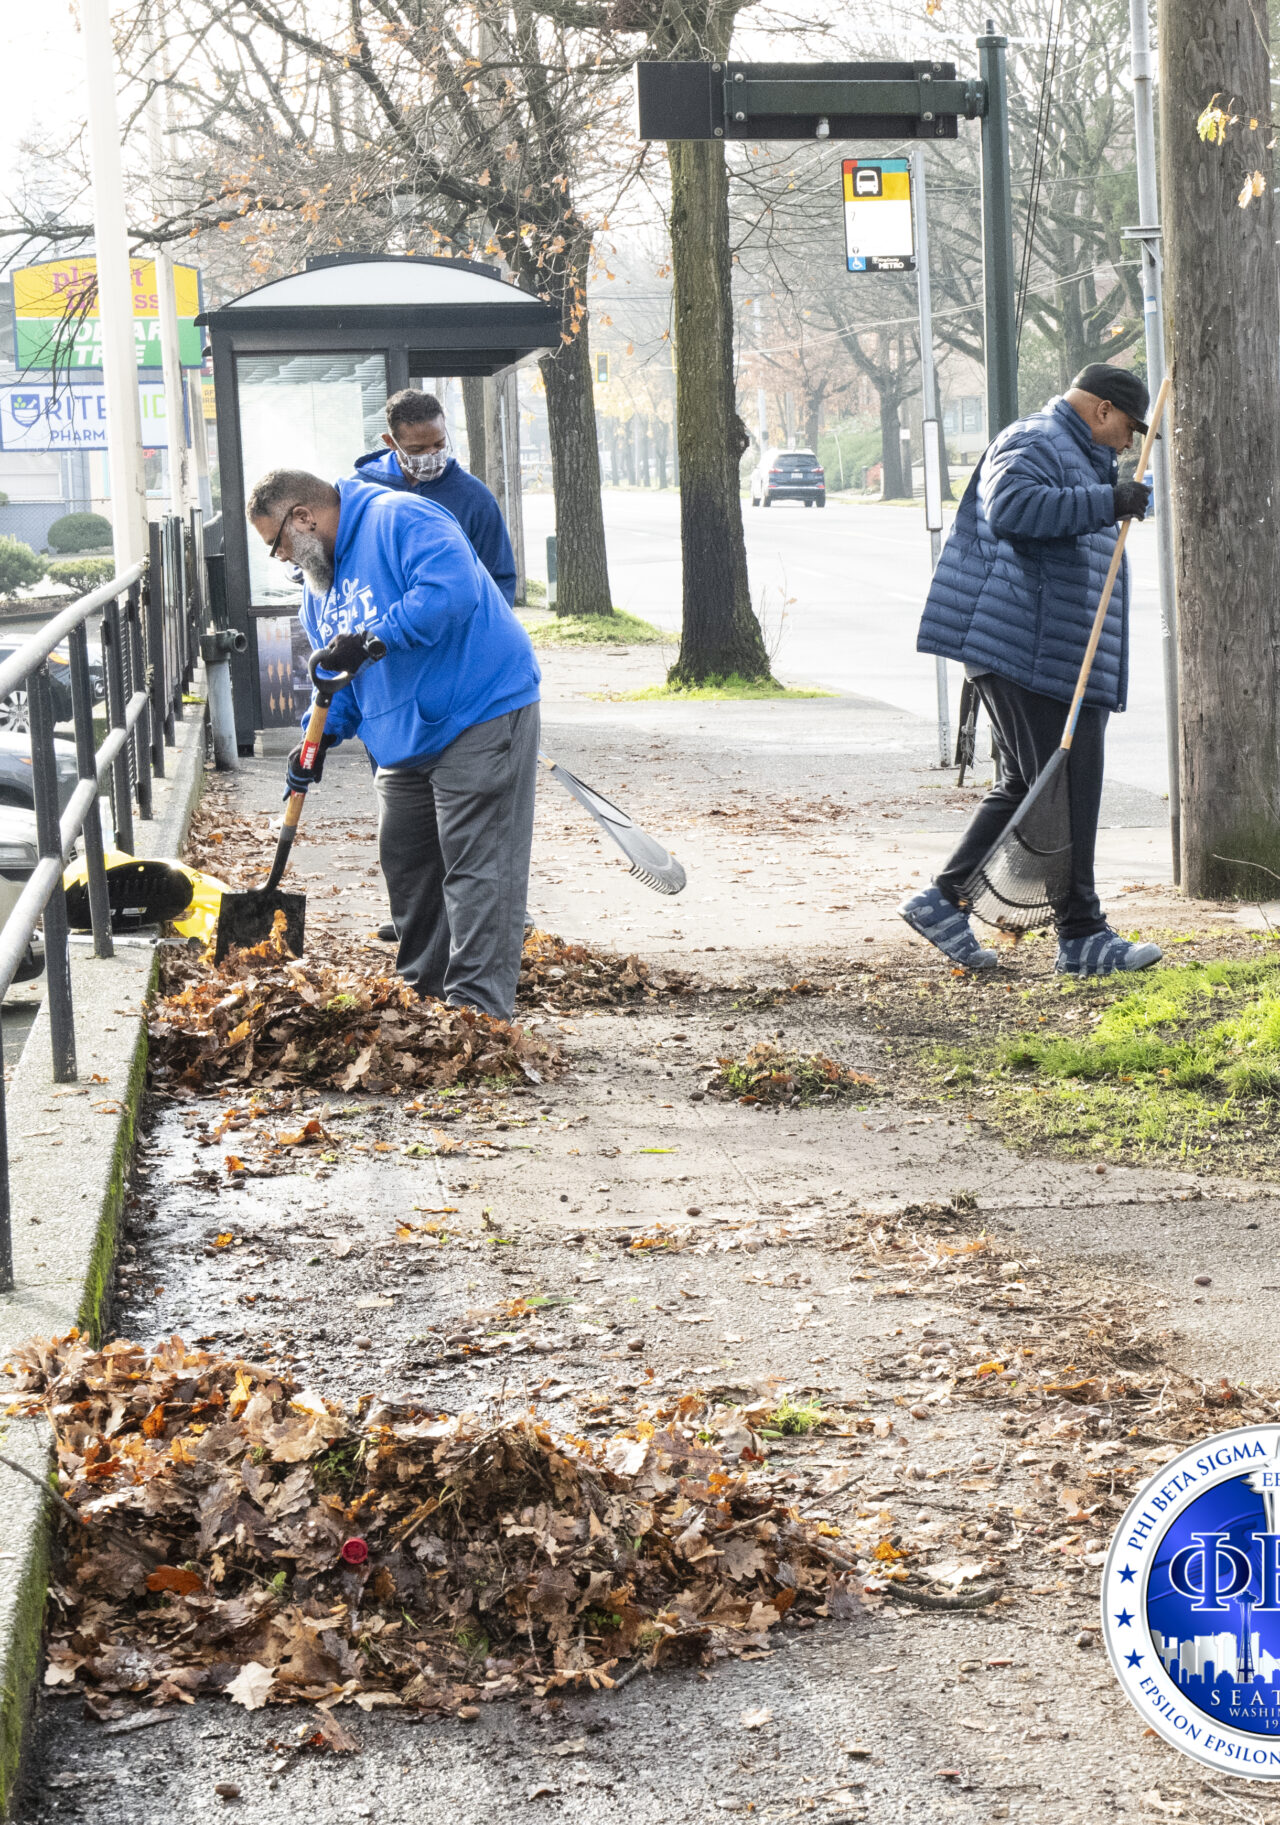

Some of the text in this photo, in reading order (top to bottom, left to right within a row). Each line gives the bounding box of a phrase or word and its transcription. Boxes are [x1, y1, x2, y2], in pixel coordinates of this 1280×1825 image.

[52, 266, 143, 293] plat
[73, 345, 146, 365] TRE
[45, 395, 106, 420] RITE
[51, 429, 107, 442] PHARM
